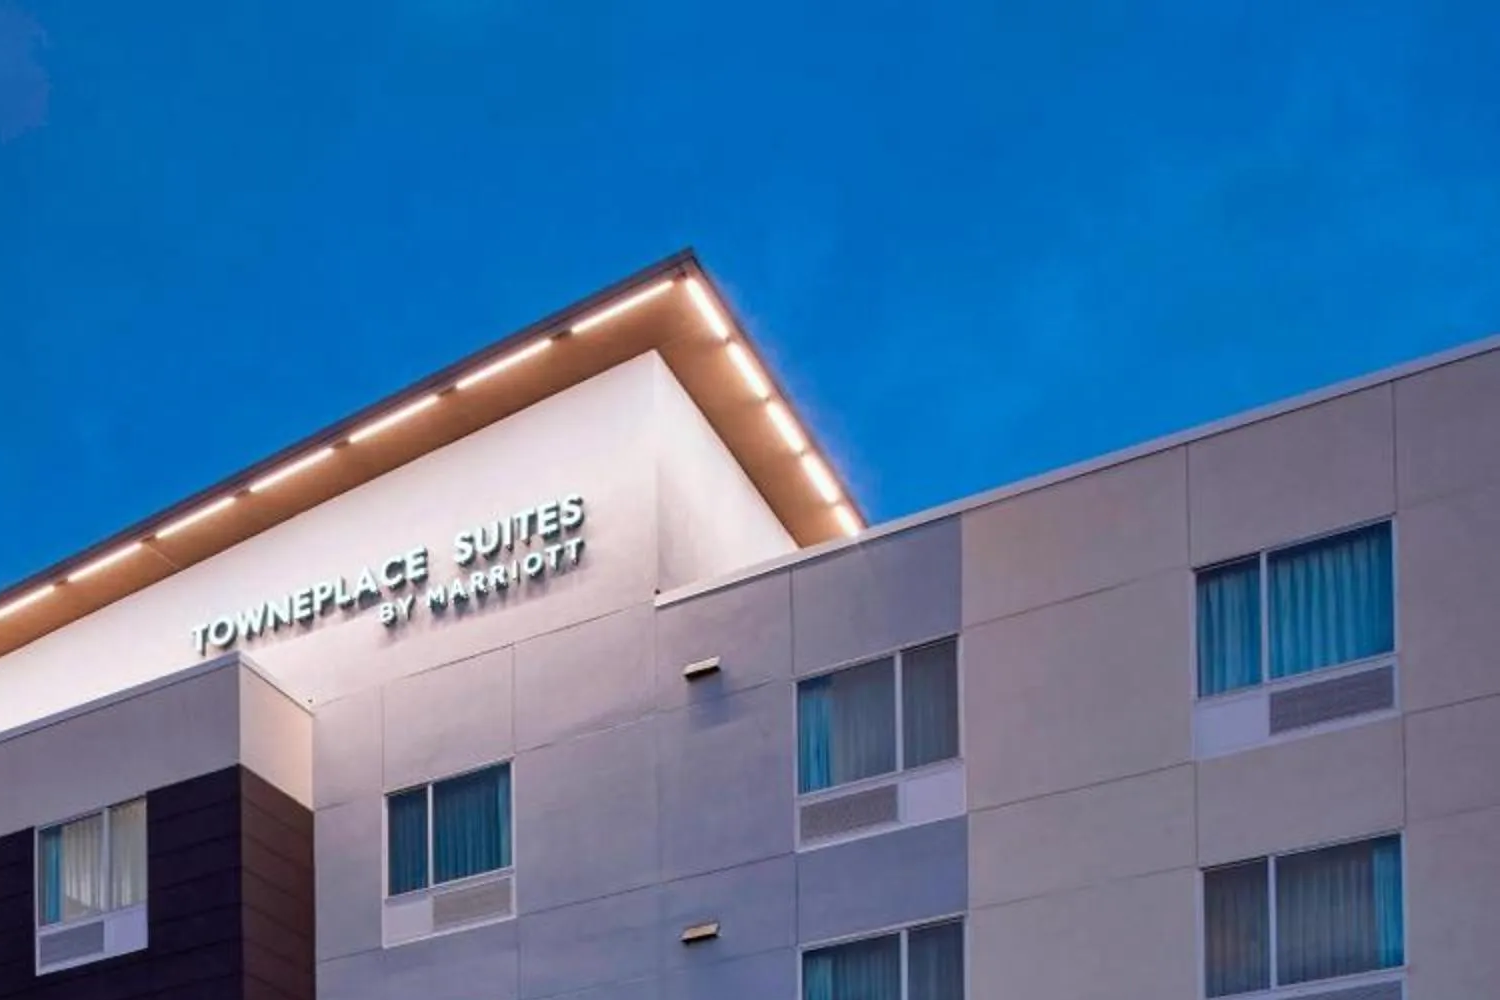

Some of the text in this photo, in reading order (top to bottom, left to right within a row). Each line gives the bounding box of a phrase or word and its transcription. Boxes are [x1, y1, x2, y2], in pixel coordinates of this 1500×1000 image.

[192, 493, 584, 653] TOWNEPLACE SUITES
[378, 538, 585, 624] BY MARRIOTT
